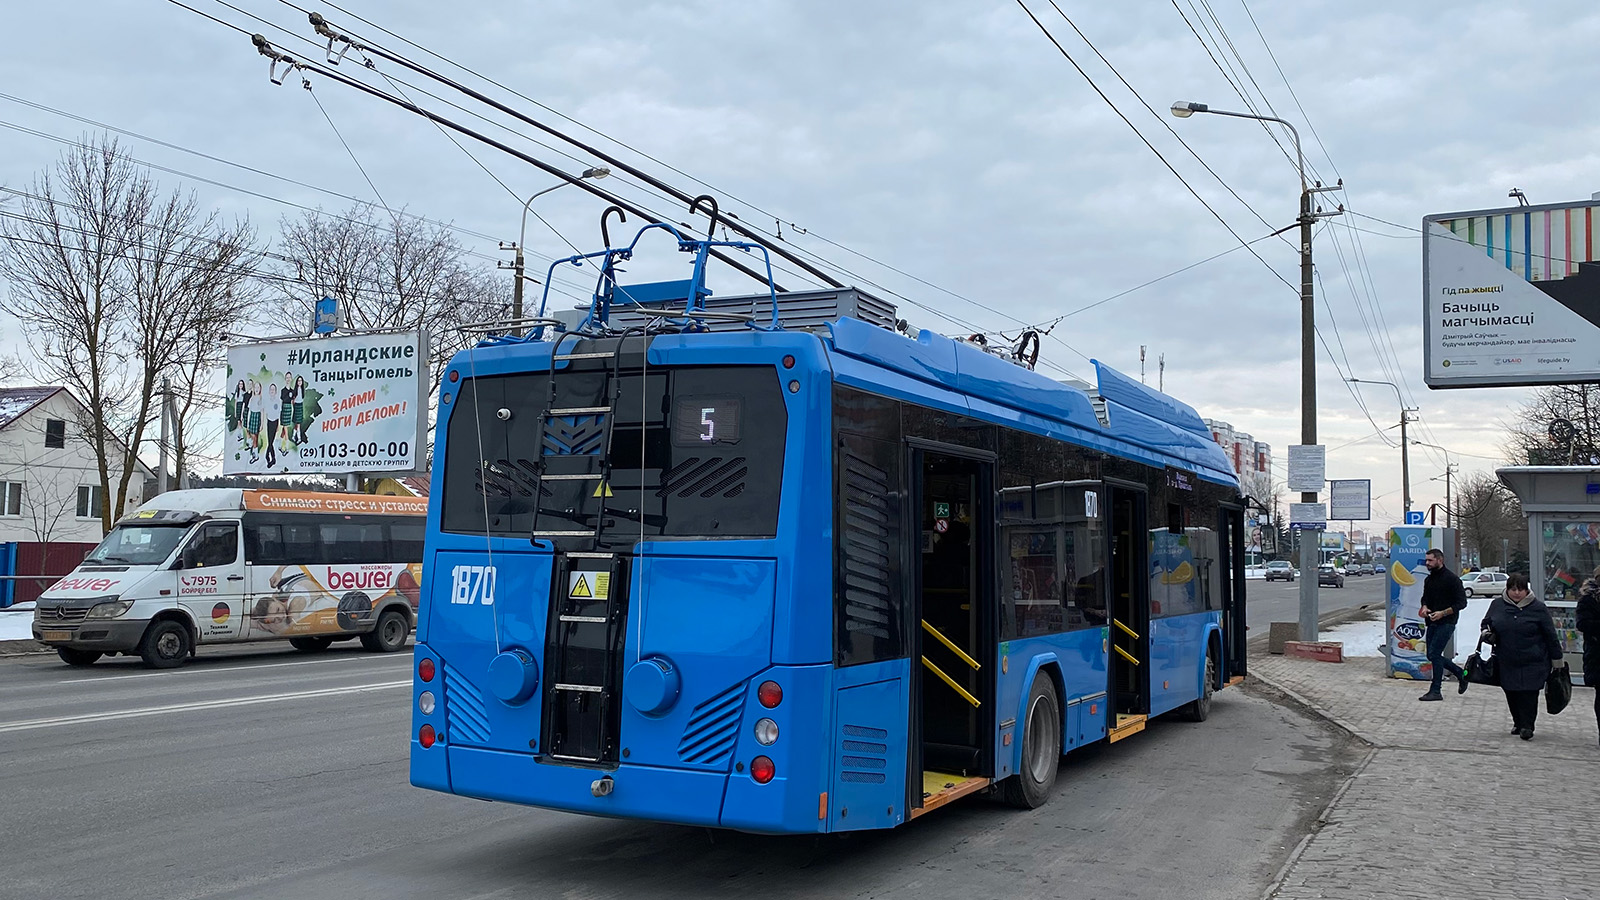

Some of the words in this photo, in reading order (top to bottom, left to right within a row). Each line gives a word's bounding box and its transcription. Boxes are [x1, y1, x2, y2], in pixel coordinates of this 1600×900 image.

[1442, 287, 1456, 296] Гід
[1471, 284, 1504, 294] жыцці
[1442, 302, 1500, 313] Бачыць
[1442, 312, 1534, 328] магчымасці
[287, 344, 414, 368] #Ирландские
[312, 367, 413, 383] ТанцыГомель
[332, 389, 376, 414] ЗАЙМИ
[322, 414, 352, 432] НОГИ
[355, 401, 407, 426] ДЕЛОМ!
[700, 408, 715, 440] 5
[259, 494, 322, 508] Снимают
[326, 499, 367, 512] стресс
[1411, 513, 1421, 525] P
[49, 578, 121, 592] beurer
[190, 576, 217, 586] 7975
[327, 566, 393, 590] beurer
[451, 565, 497, 605] 1870
[1397, 626, 1422, 638] AQUA
